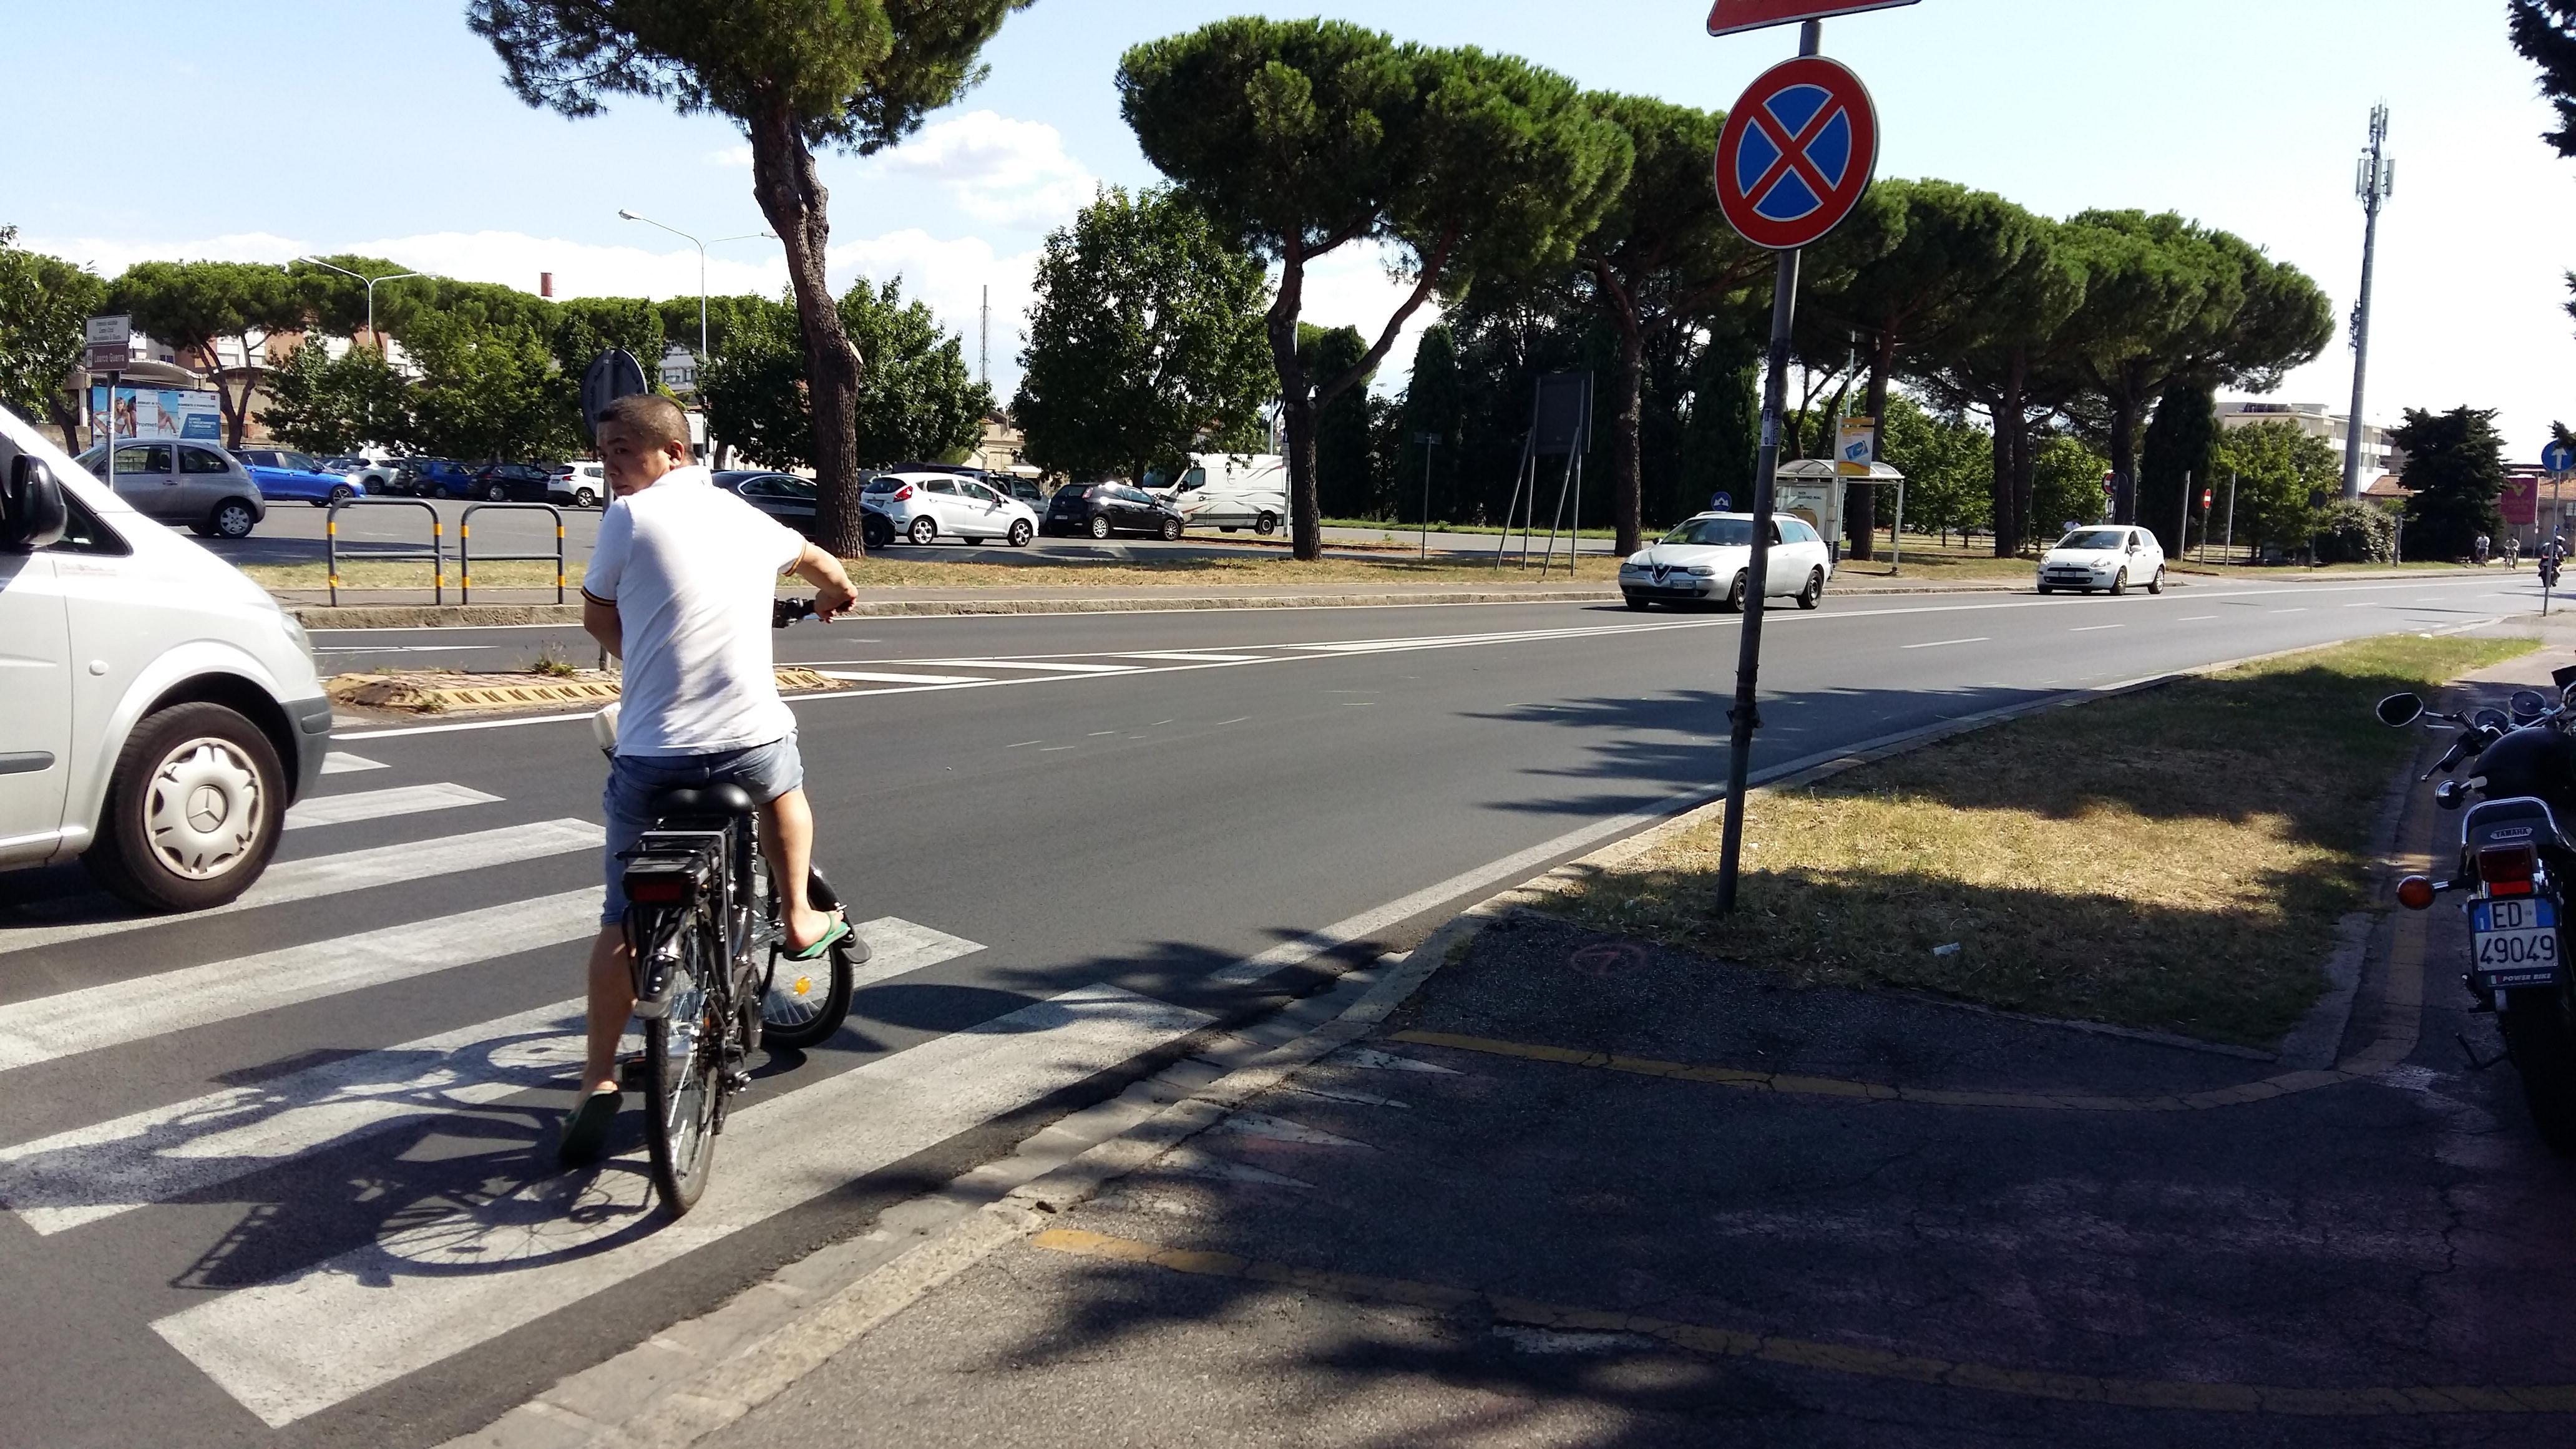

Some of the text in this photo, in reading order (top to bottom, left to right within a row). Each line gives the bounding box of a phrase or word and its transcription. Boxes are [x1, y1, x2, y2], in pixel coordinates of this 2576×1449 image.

[109, 353, 124, 362] Guerra
[2496, 828, 2529, 838] YAMAHA
[2492, 902, 2522, 928] ED
[2480, 935, 2555, 964] 49049
